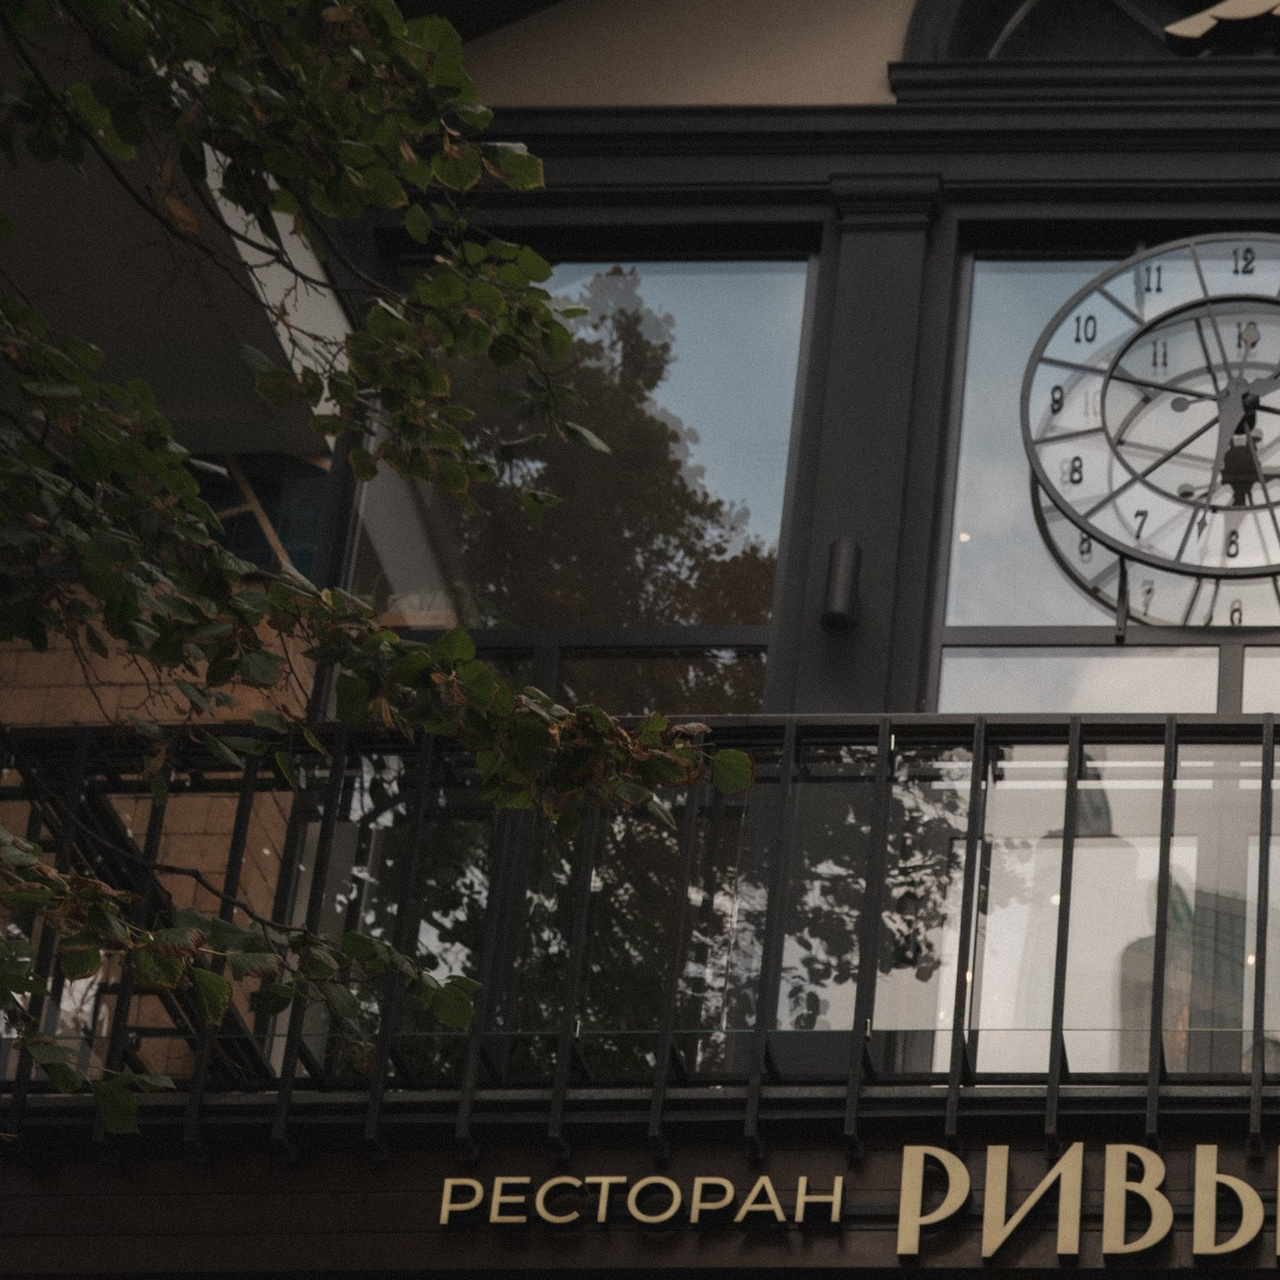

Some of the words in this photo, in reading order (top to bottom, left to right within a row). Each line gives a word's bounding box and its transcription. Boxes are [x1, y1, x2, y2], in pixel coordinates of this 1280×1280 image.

[1232, 248, 1255, 275] 12
[1145, 265, 1162, 293] 11
[1074, 314, 1098, 343] 10
[1051, 385, 1064, 415] 9
[1070, 456, 1083, 485] 8
[1134, 510, 1149, 540] 7
[439, 1175, 844, 1225] РЕСТОРАН
